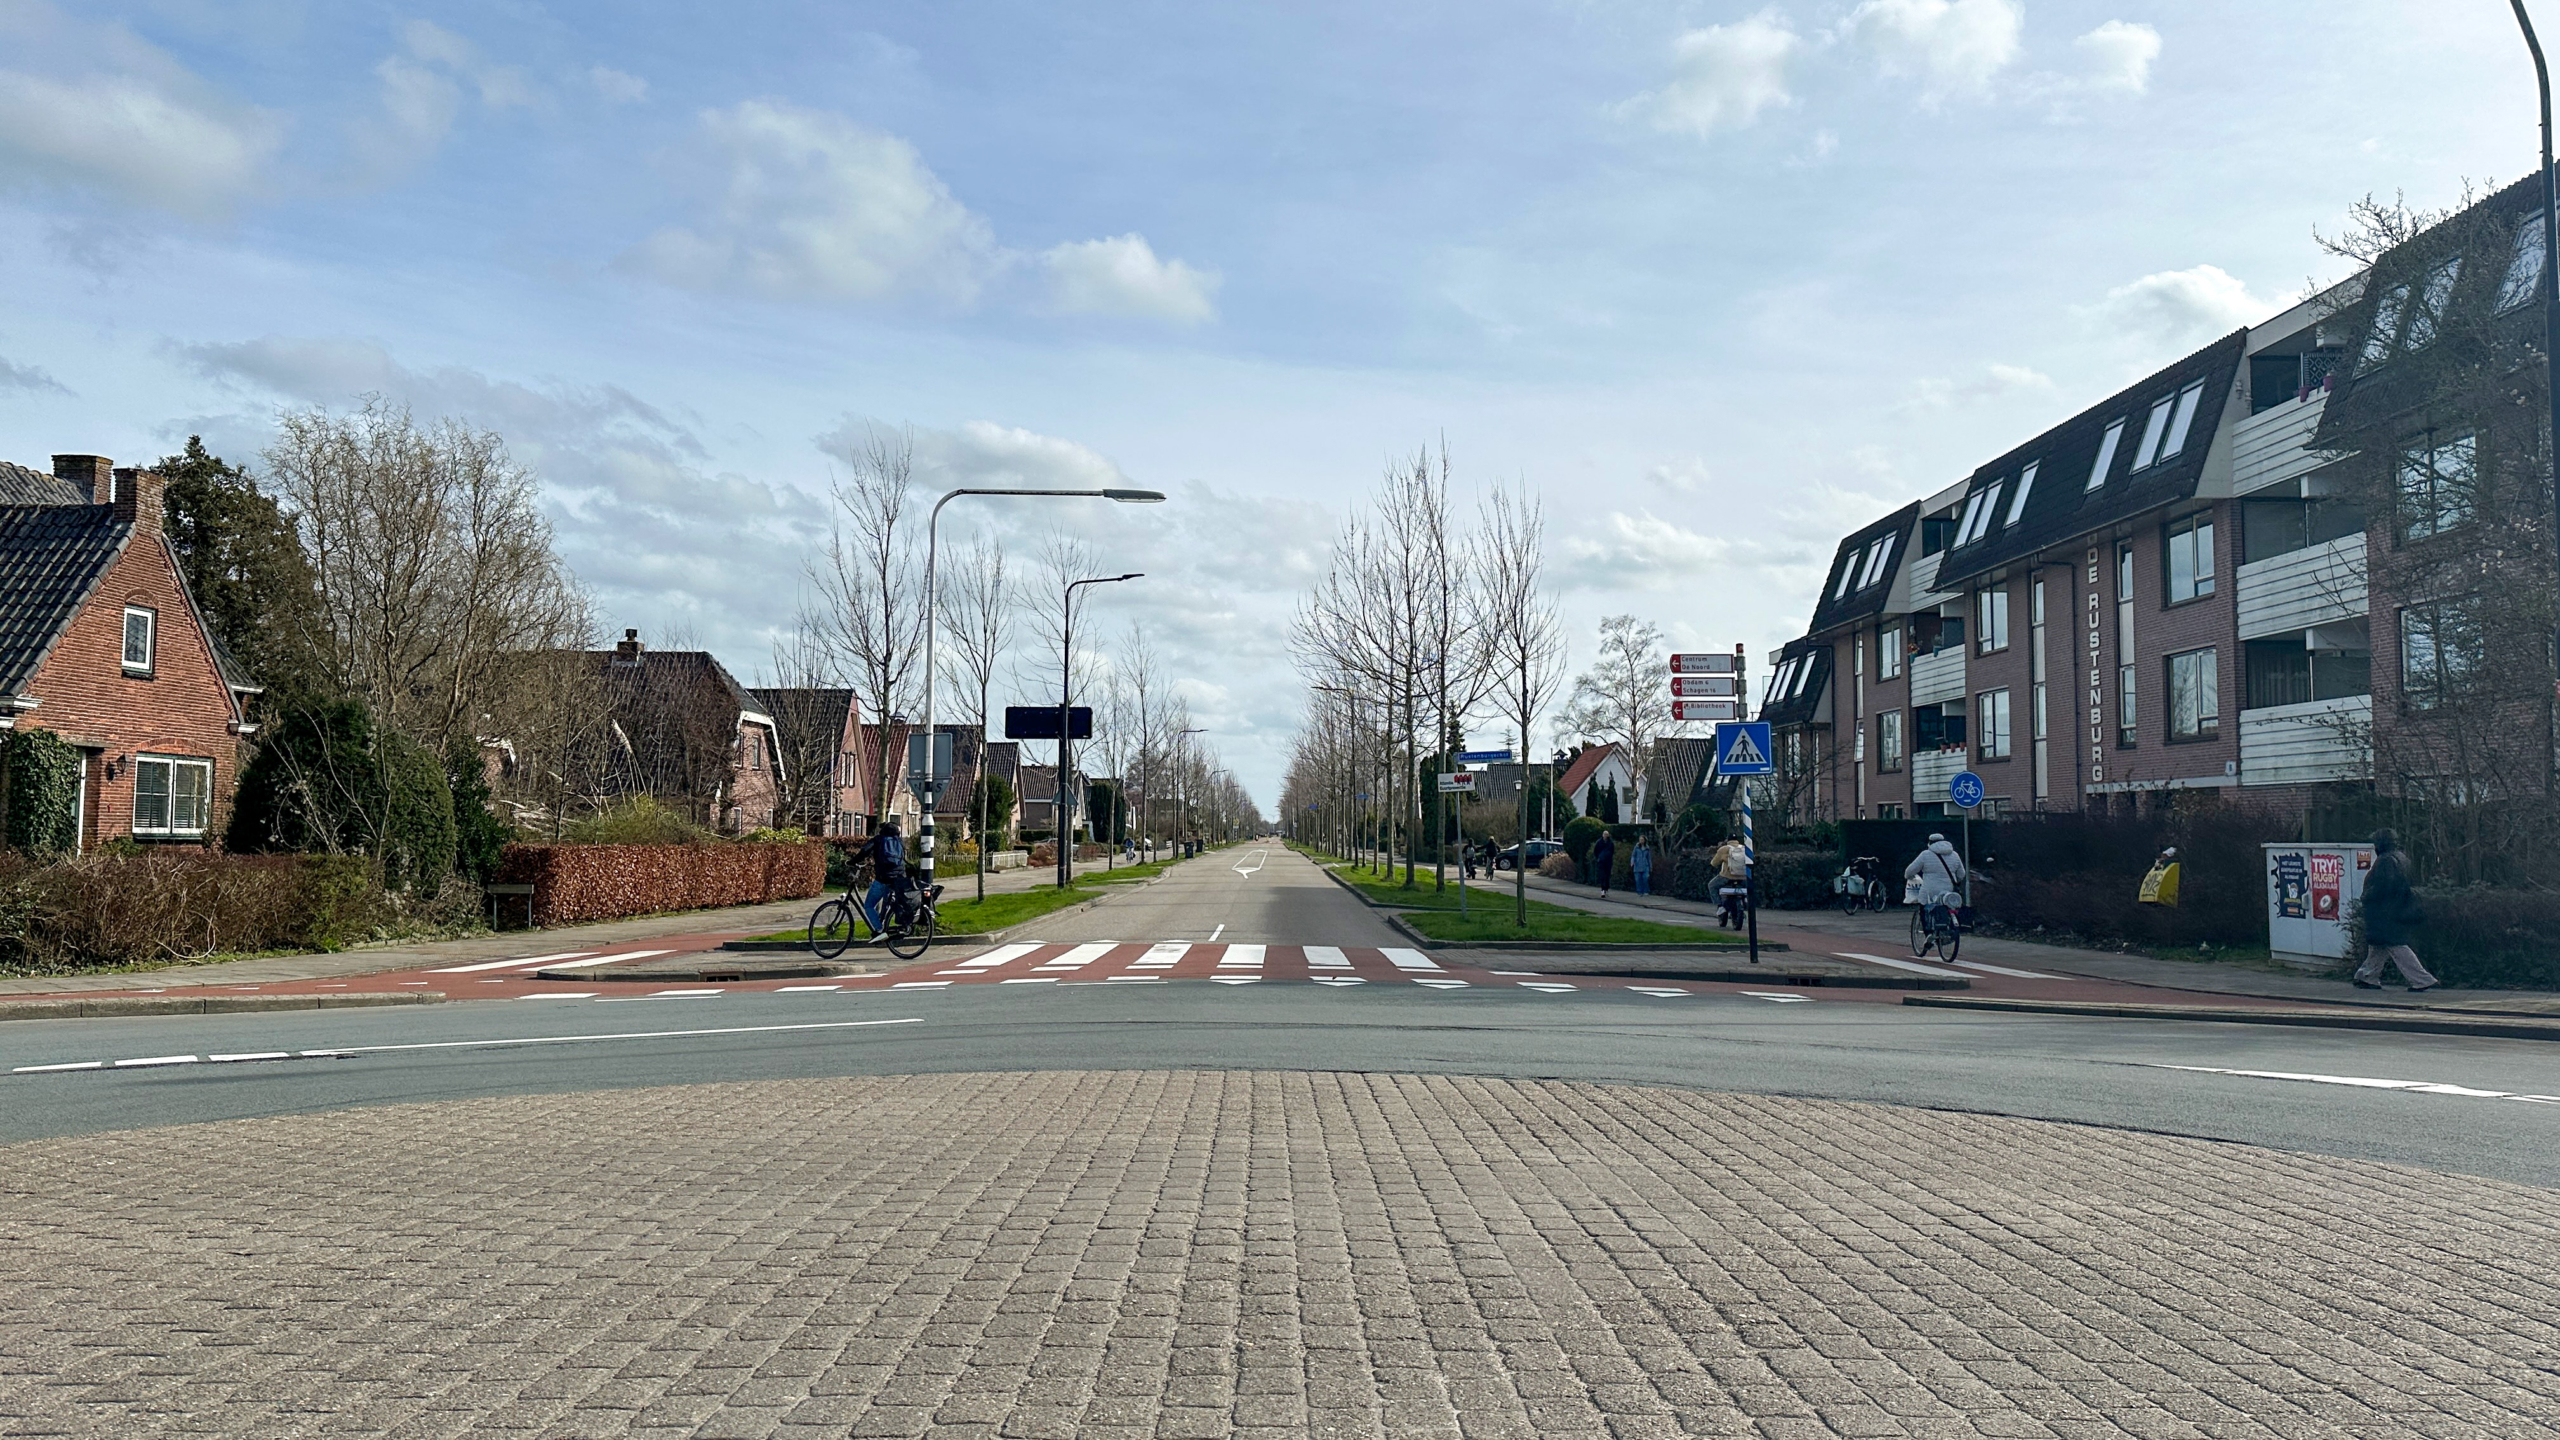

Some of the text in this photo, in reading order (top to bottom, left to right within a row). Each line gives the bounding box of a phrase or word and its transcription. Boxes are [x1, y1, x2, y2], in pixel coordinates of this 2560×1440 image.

[2087, 547, 2103, 782] DE RUSTENBURG
[2312, 858, 2338, 874] TRY!
[2313, 872, 2338, 883] RUGBY
